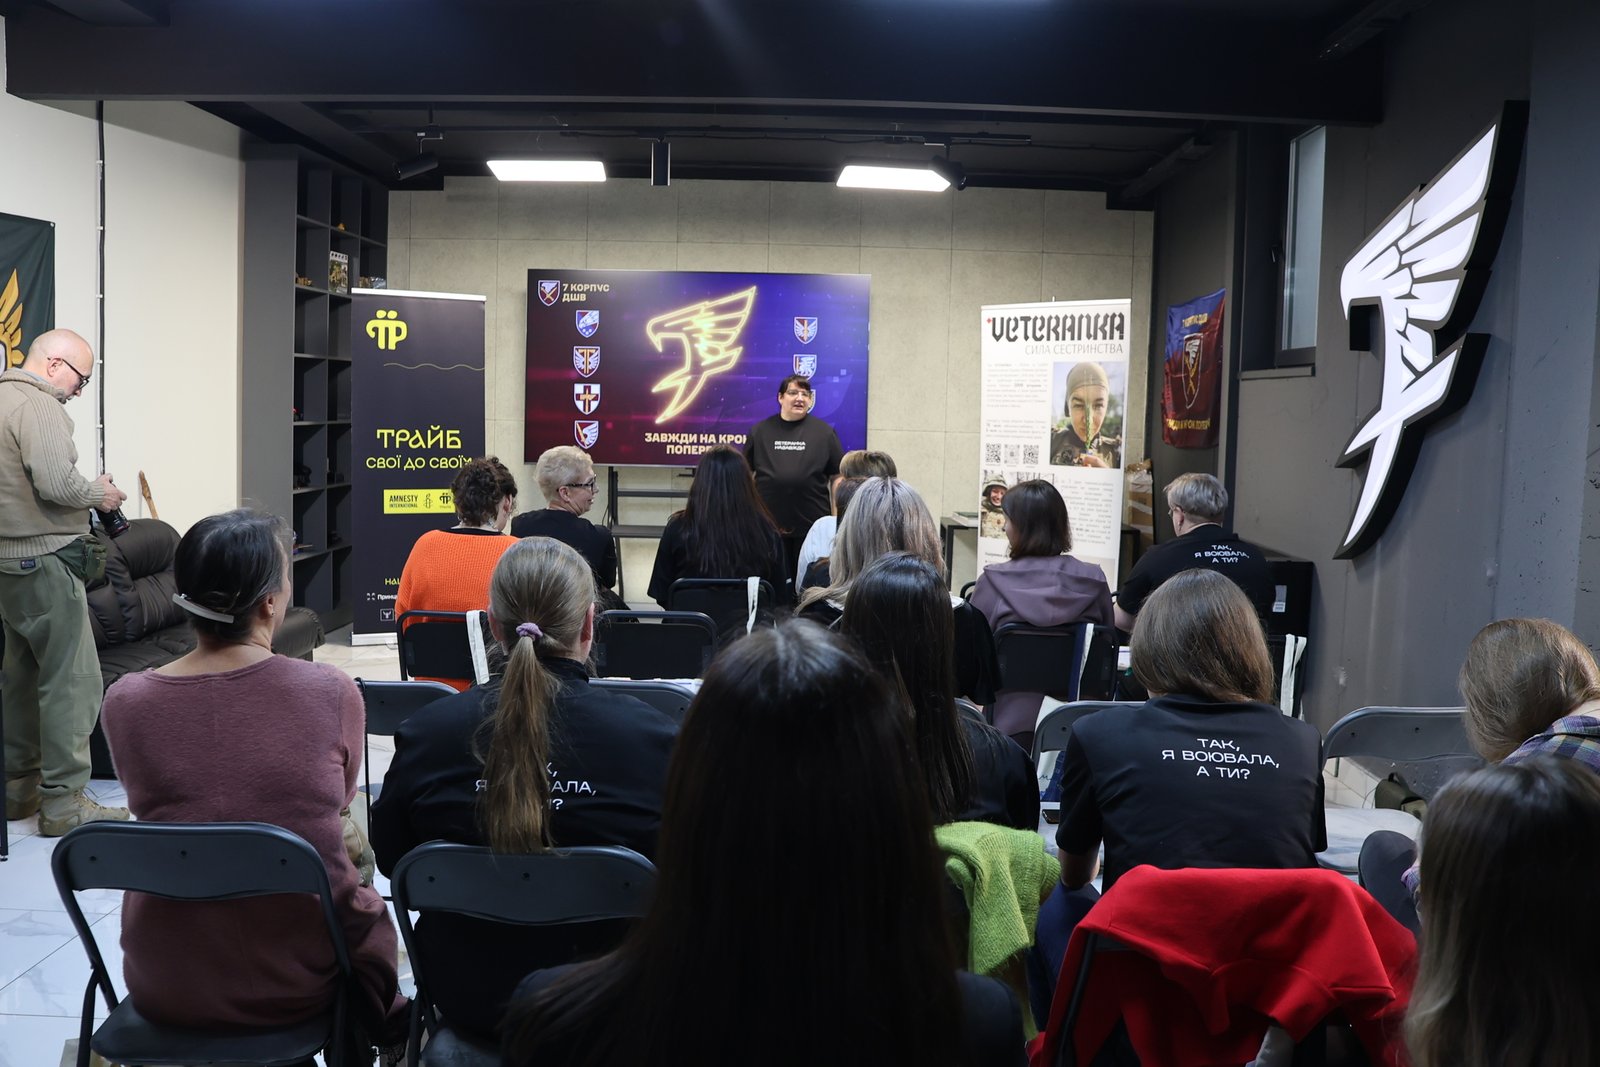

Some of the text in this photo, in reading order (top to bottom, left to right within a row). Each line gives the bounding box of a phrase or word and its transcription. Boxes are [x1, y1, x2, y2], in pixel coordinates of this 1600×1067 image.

[562, 283, 569, 292] 7
[562, 293, 587, 303] ДШВ
[1025, 343, 1124, 355] СИЛА СЕСТРИНСТВА
[376, 425, 462, 449] ТРАЙБ
[644, 432, 698, 444] ЗАВЖДИ
[699, 433, 717, 444] НА
[389, 494, 418, 503] AMNESTY
[1197, 738, 1240, 752] ТАК,
[1161, 749, 1280, 769] Я ВОЮВАЛА,
[1196, 765, 1251, 780] А ТИ?
